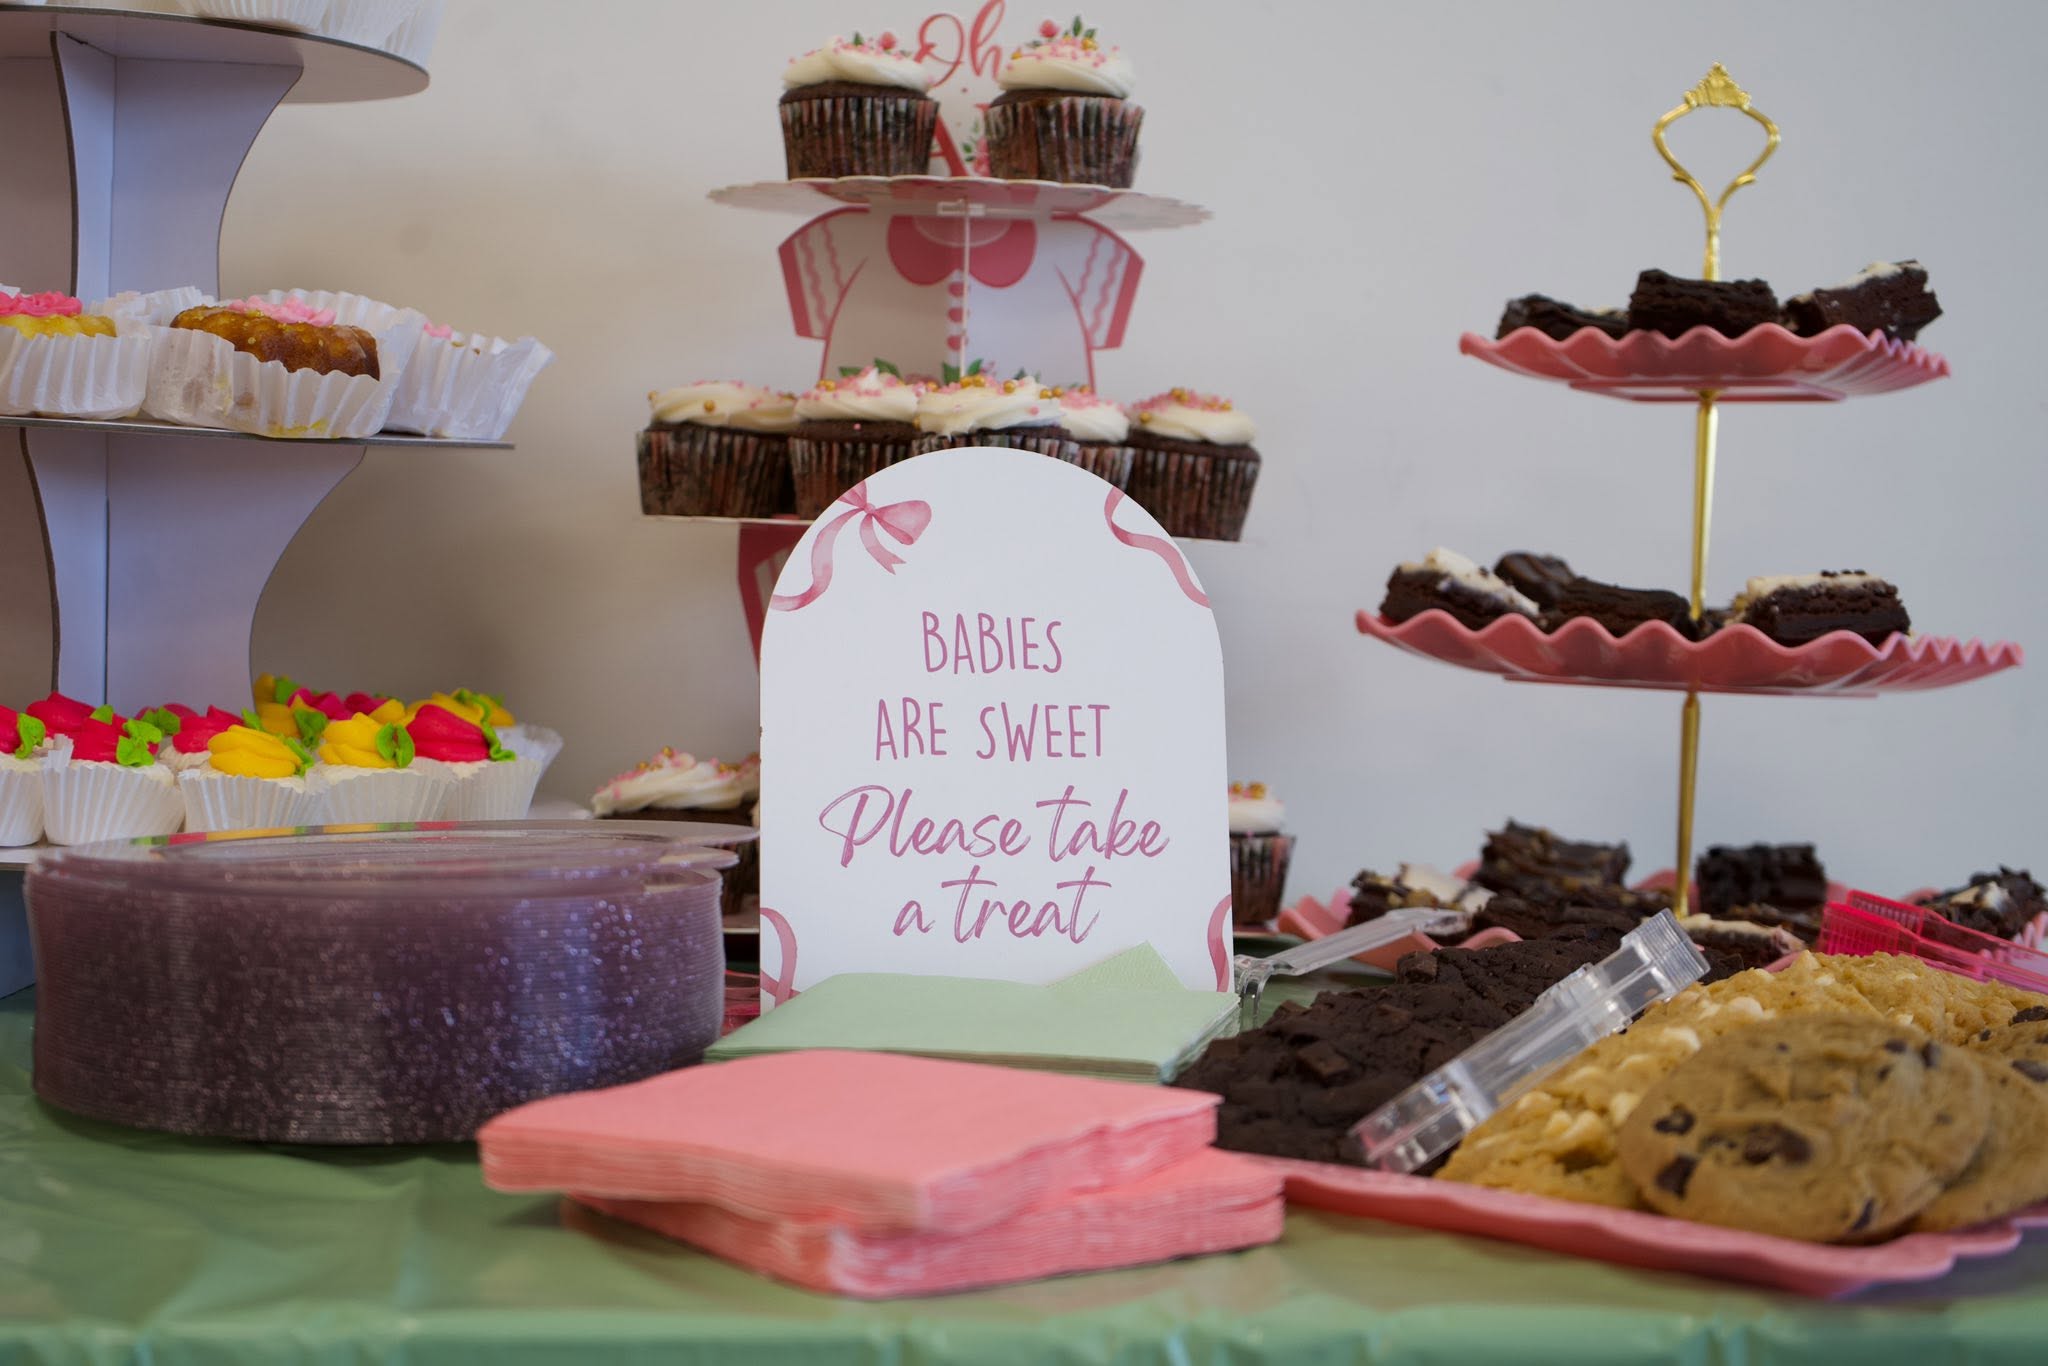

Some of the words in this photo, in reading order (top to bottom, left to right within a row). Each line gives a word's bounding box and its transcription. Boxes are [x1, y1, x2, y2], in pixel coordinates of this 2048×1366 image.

[913, 0, 1005, 87] Oh
[922, 610, 1063, 674] BABIES
[876, 698, 947, 761] ARE
[976, 702, 1111, 762] SWEET
[818, 784, 1032, 867] Please
[1035, 784, 1169, 861] take
[892, 901, 936, 937] a
[941, 864, 1113, 944] treat
